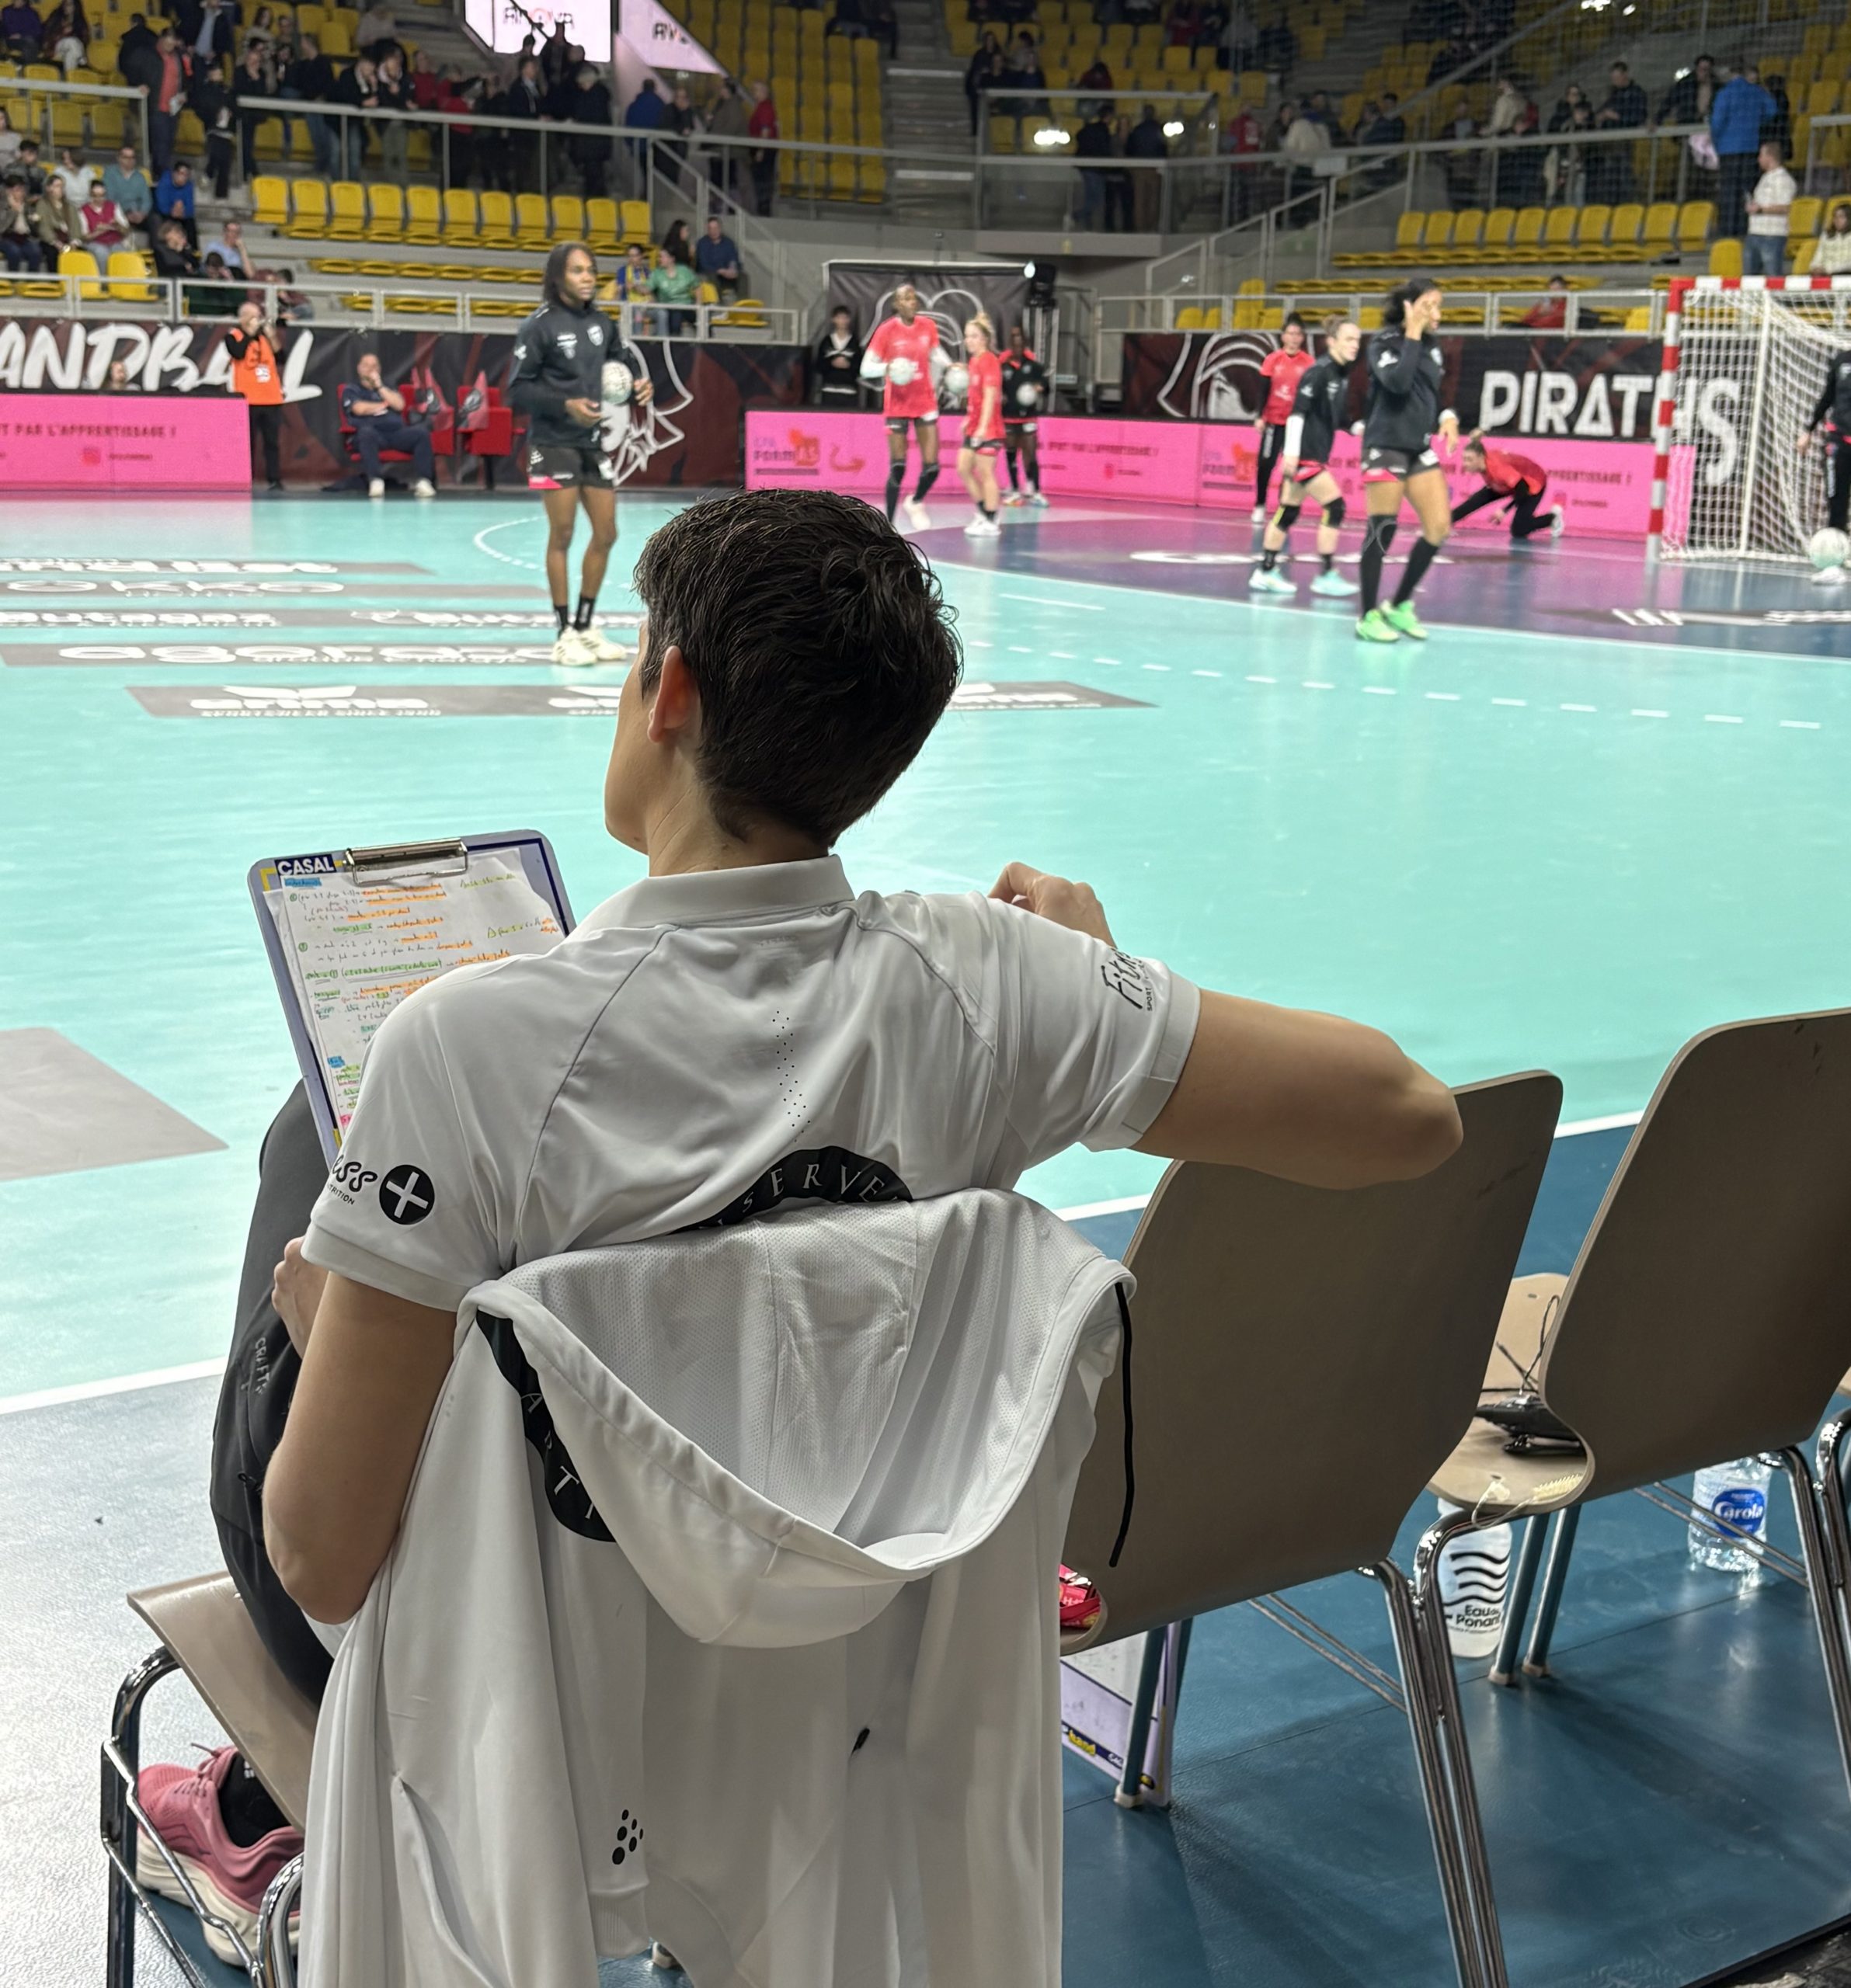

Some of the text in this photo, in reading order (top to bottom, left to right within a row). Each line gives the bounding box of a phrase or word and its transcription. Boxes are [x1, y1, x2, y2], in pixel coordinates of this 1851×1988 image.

[0, 321, 323, 404] ANDBAL
[277, 856, 335, 875] CASAL
[326, 1183, 356, 1205] TRITION
[698, 1163, 899, 1229] SERVE
[1714, 1501, 1763, 1520] Carola
[1465, 1604, 1491, 1617] Eau
